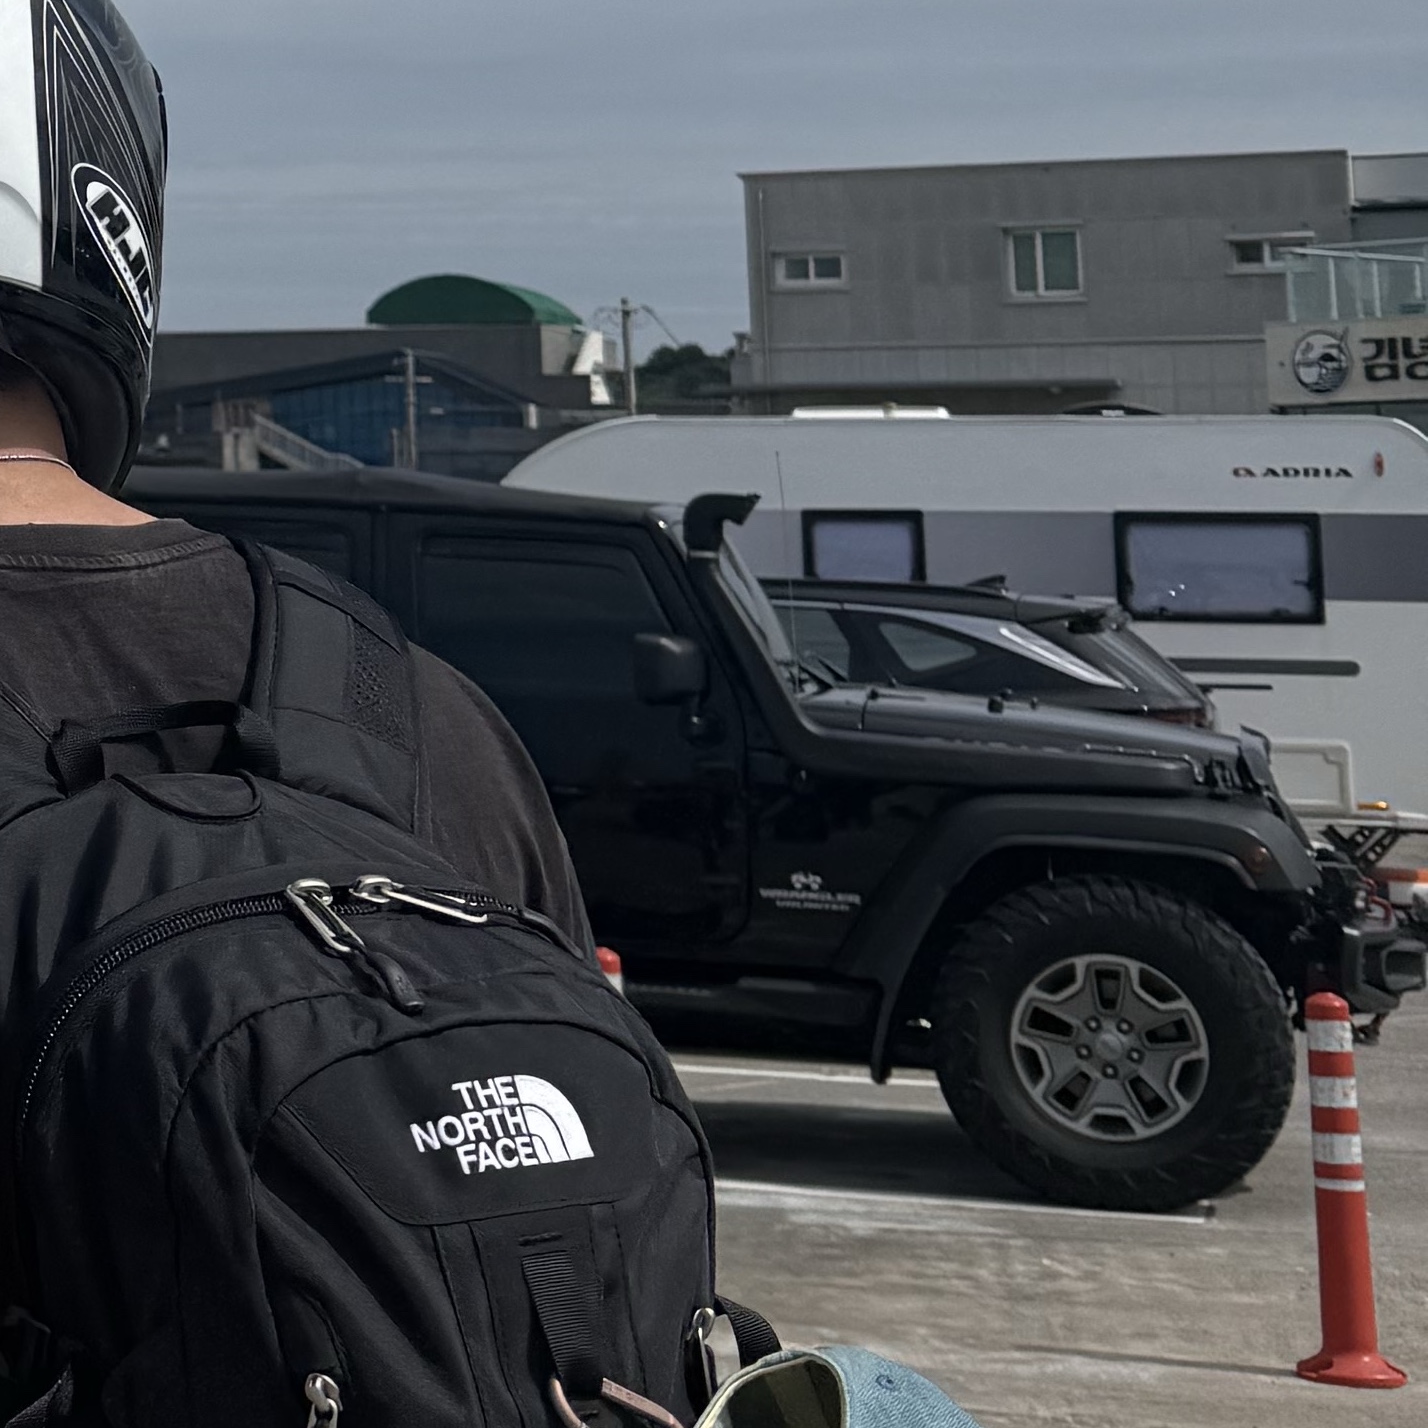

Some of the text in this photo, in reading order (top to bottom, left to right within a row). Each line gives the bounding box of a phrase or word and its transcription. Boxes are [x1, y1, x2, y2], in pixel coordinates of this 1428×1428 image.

[1262, 466, 1354, 479] ADRIA
[451, 1075, 519, 1110] THE
[409, 1105, 530, 1153] NORTH
[456, 1135, 539, 1174] FACE
